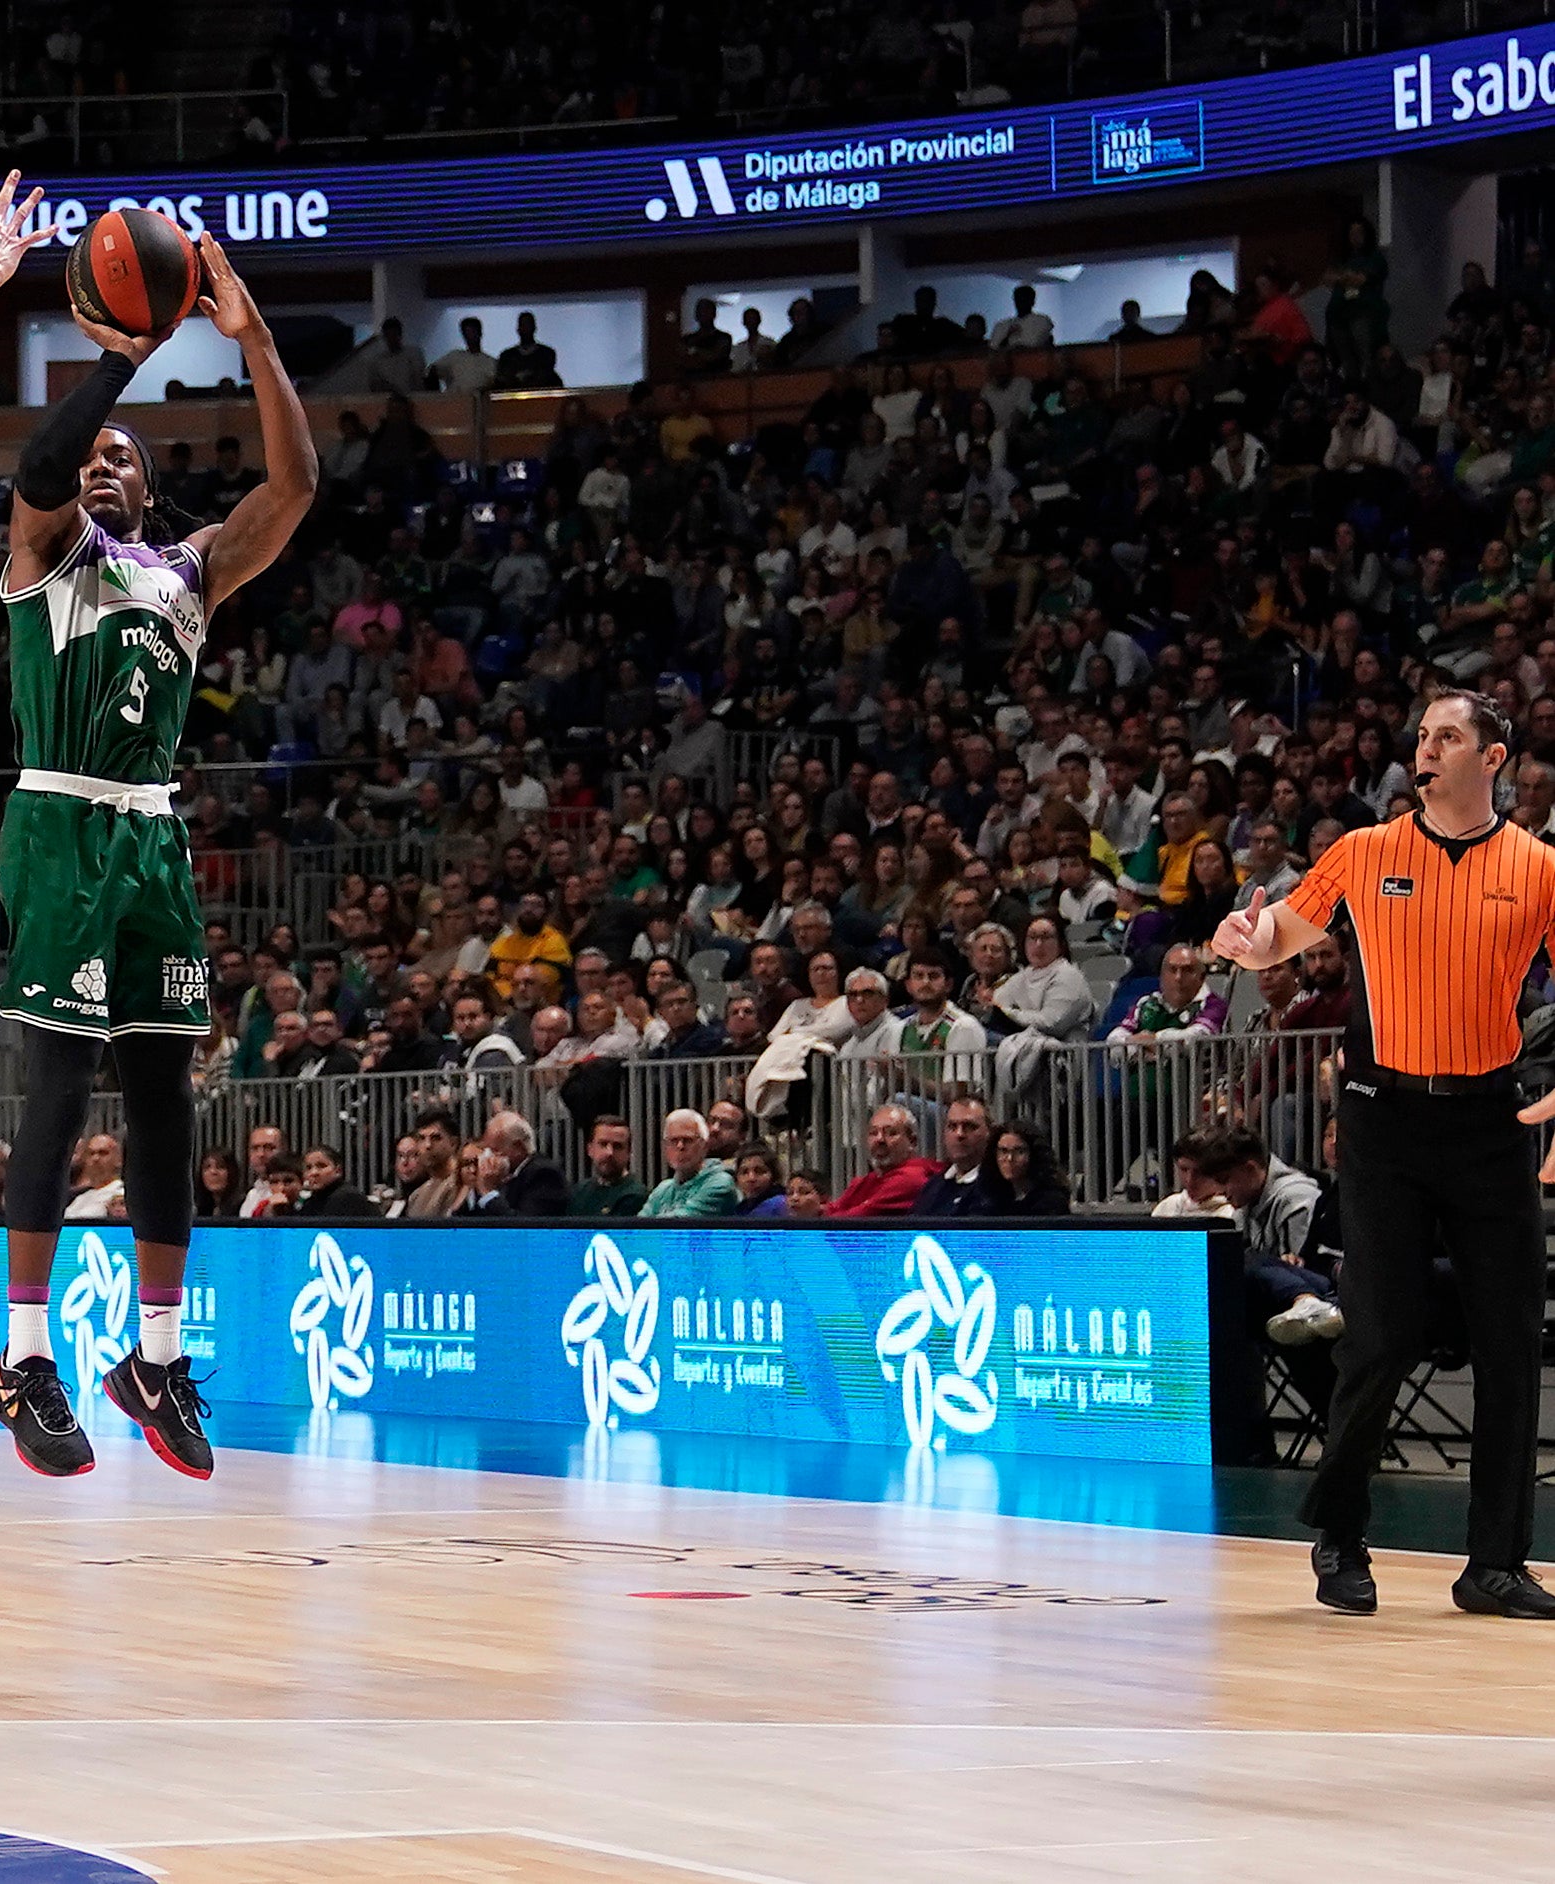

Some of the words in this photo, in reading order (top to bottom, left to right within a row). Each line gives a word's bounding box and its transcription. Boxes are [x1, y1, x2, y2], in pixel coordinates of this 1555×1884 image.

[1393, 53, 1433, 131] El
[1452, 38, 1555, 121] sabo
[745, 143, 884, 182] Diputación
[891, 126, 1015, 165] Provincial
[1102, 143, 1153, 174] laga
[225, 188, 330, 241] une
[746, 188, 780, 213] de
[786, 179, 881, 210] Málaga
[119, 666, 150, 725] 5
[162, 975, 206, 1006] laga
[383, 1280, 476, 1331] MÁLAGA
[672, 1287, 784, 1343] MÁLAGA
[1013, 1293, 1152, 1357] MÁLAGA
